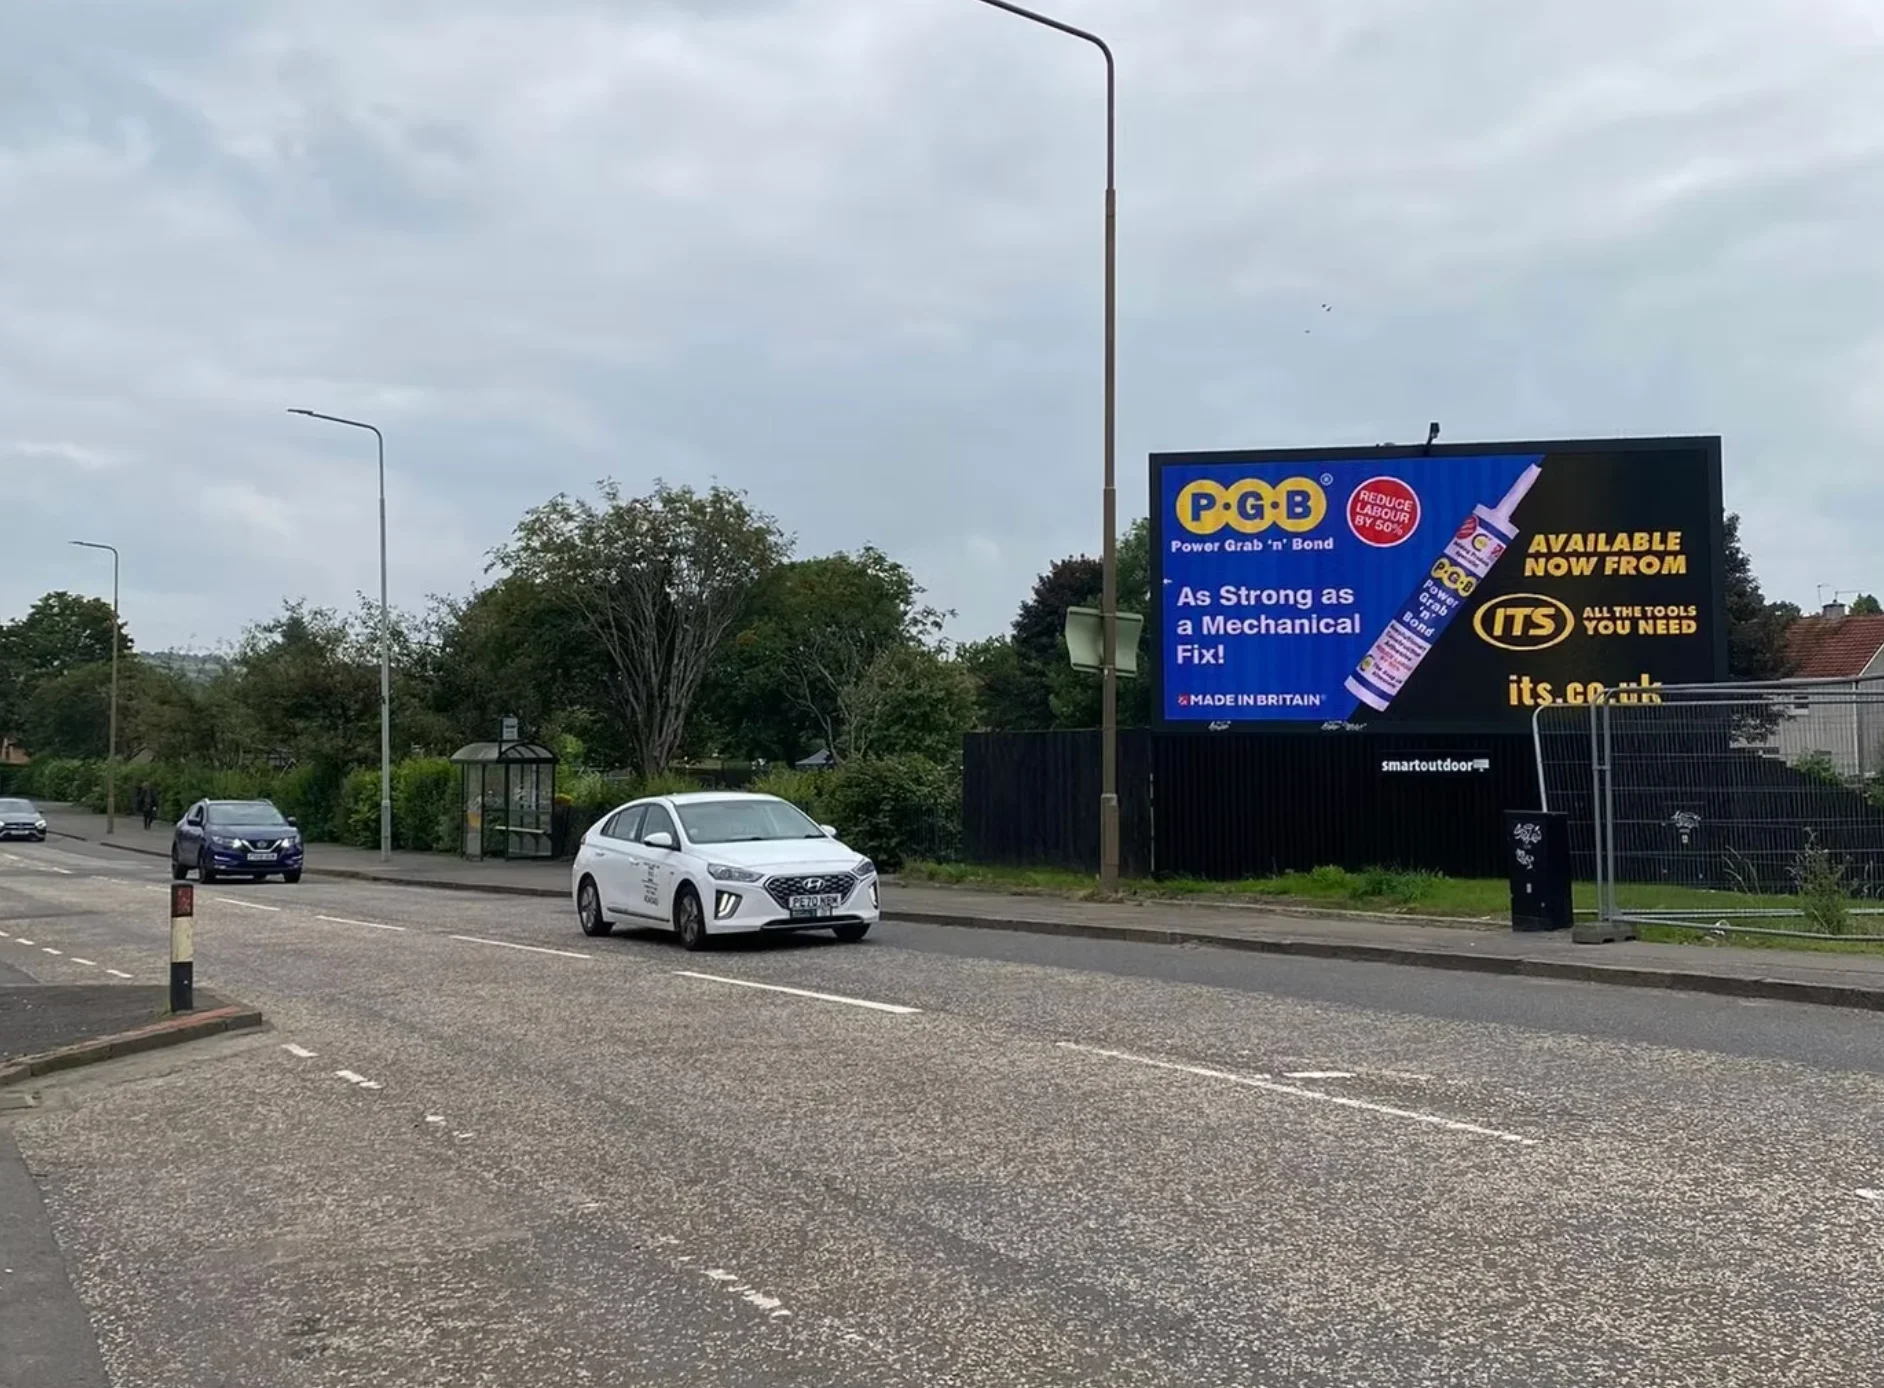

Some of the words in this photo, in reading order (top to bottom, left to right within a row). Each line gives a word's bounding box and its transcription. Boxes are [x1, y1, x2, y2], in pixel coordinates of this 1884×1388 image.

[1359, 490, 1413, 511] REDUCE
[1356, 502, 1410, 523] LABOUR
[1354, 514, 1374, 527] BY
[1375, 519, 1403, 535] 50%
[1171, 540, 1220, 553] Power
[1224, 539, 1263, 552] Grab
[1292, 537, 1334, 550] Bond
[1527, 531, 1682, 553] AVAILABLE
[1524, 556, 1598, 577] NOW
[1604, 555, 1687, 575] FROM
[1177, 586, 1211, 606] As
[1219, 585, 1312, 609] Strong
[1321, 588, 1355, 604] as
[1419, 592, 1448, 616] Grab
[1423, 579, 1459, 608] Power
[1492, 607, 1556, 636] ITS
[1582, 607, 1611, 617] ALL
[1613, 606, 1642, 617] THE
[1644, 605, 1697, 617] TOOLS
[1177, 619, 1193, 635] a
[1202, 613, 1360, 635] Mechanical
[1402, 611, 1435, 637] Bond
[1583, 620, 1631, 635] YOU
[1638, 619, 1697, 635] NEED
[1177, 644, 1225, 664] Fix!
[1190, 694, 1235, 706] MADE
[1237, 694, 1254, 706] IN
[1256, 694, 1320, 706] BRITAIN
[1381, 758, 1473, 772] smartoutdoor
